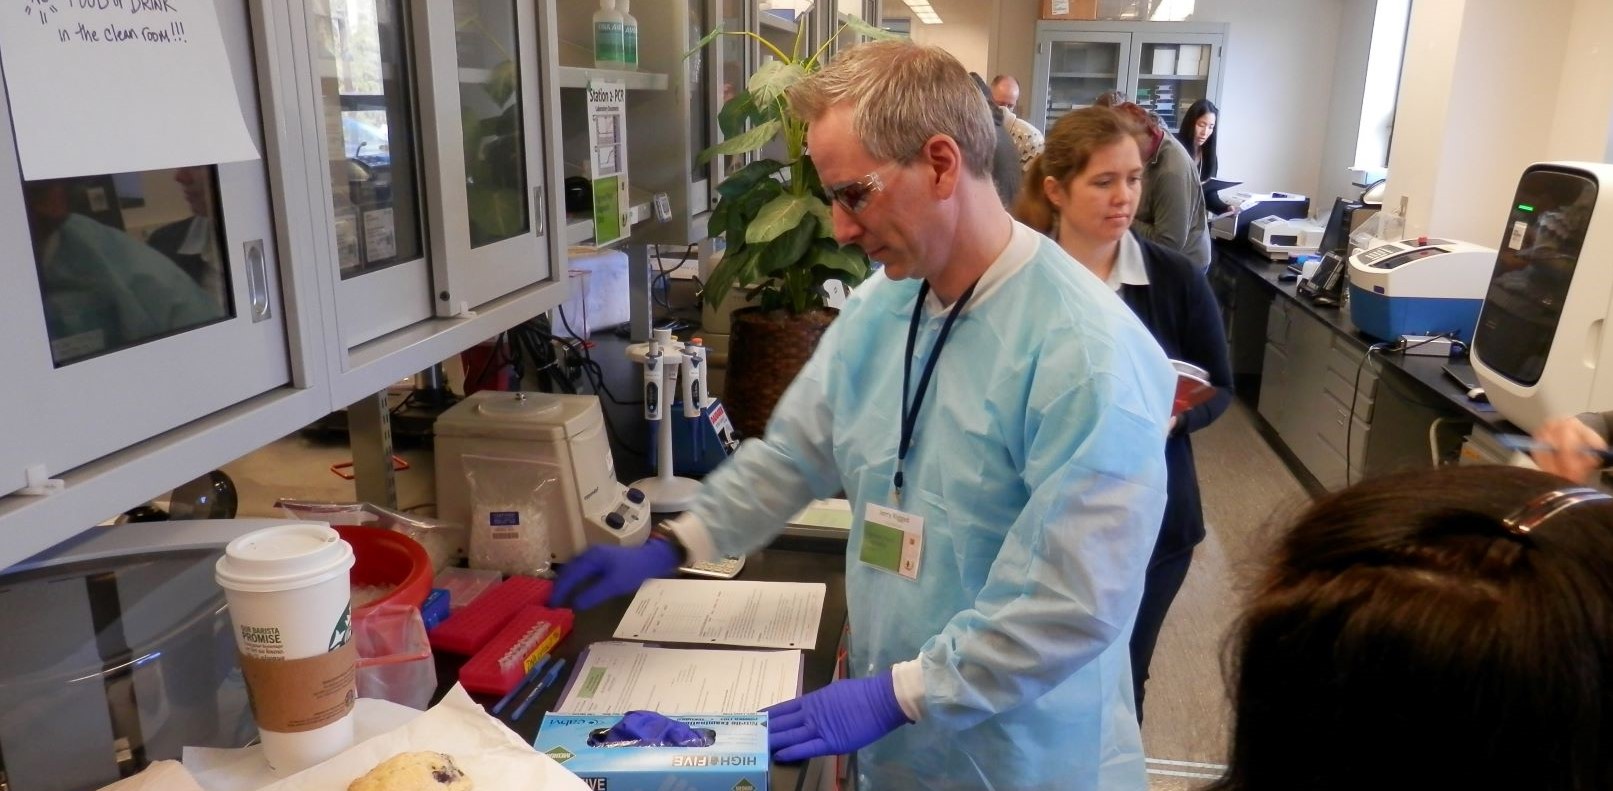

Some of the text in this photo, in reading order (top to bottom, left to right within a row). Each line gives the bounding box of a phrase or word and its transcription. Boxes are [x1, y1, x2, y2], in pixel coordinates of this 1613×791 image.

[131, 0, 177, 14] DRINK
[58, 28, 70, 42] in
[75, 22, 99, 42] the
[104, 24, 138, 42] clean
[590, 88, 609, 103] Station
[615, 89, 624, 102] PCR
[242, 631, 281, 644] PROMISE
[252, 627, 280, 635] BARISTA
[673, 756, 757, 767] HIGH FIVE
